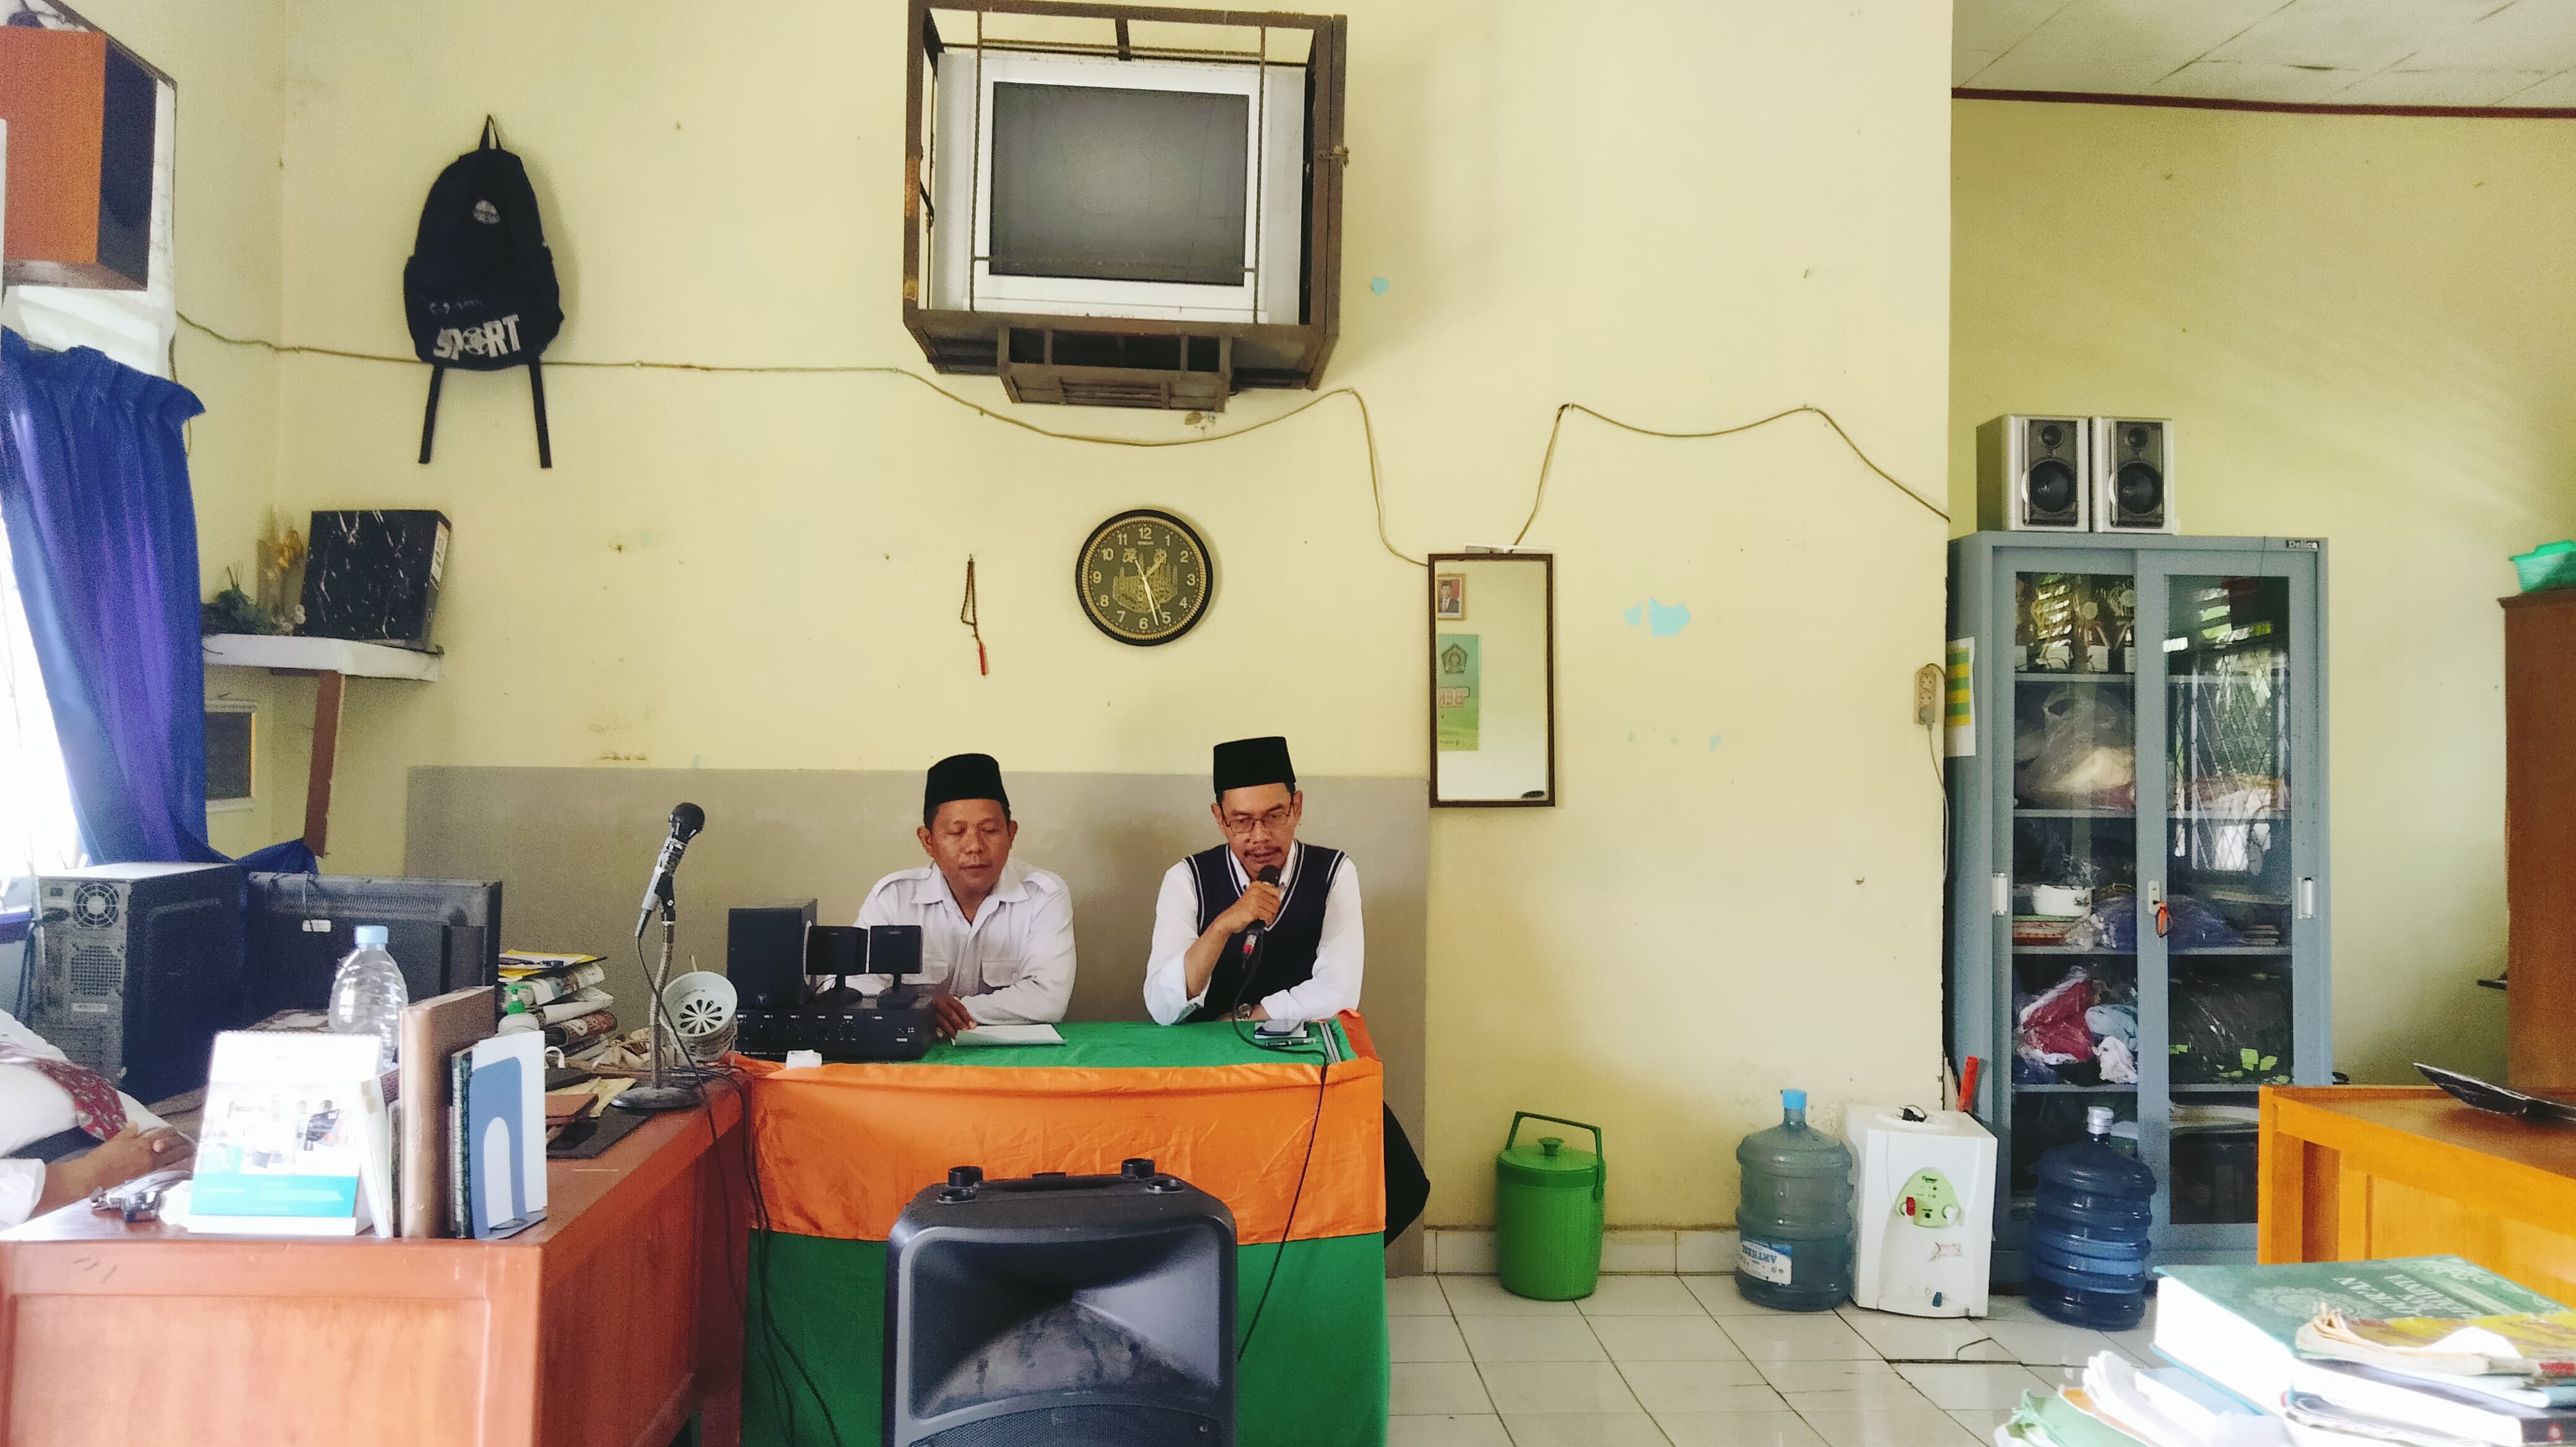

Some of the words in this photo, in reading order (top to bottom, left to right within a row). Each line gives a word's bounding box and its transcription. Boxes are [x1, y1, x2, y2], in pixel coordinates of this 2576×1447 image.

[433, 313, 521, 361] SPORT
[1117, 533, 1128, 546] 11
[1138, 527, 1152, 540] 12
[1165, 536, 1170, 547] 1
[2288, 540, 2318, 548] Delica
[1102, 548, 1113, 561] 10
[1180, 551, 1190, 563] 2
[1092, 571, 1102, 584] 9
[1186, 574, 1196, 586] 3
[1100, 595, 1109, 607] 8
[1179, 597, 1188, 608] 4
[1116, 611, 1126, 623] 7
[1162, 612, 1171, 624] 5
[1139, 618, 1149, 630] 6
